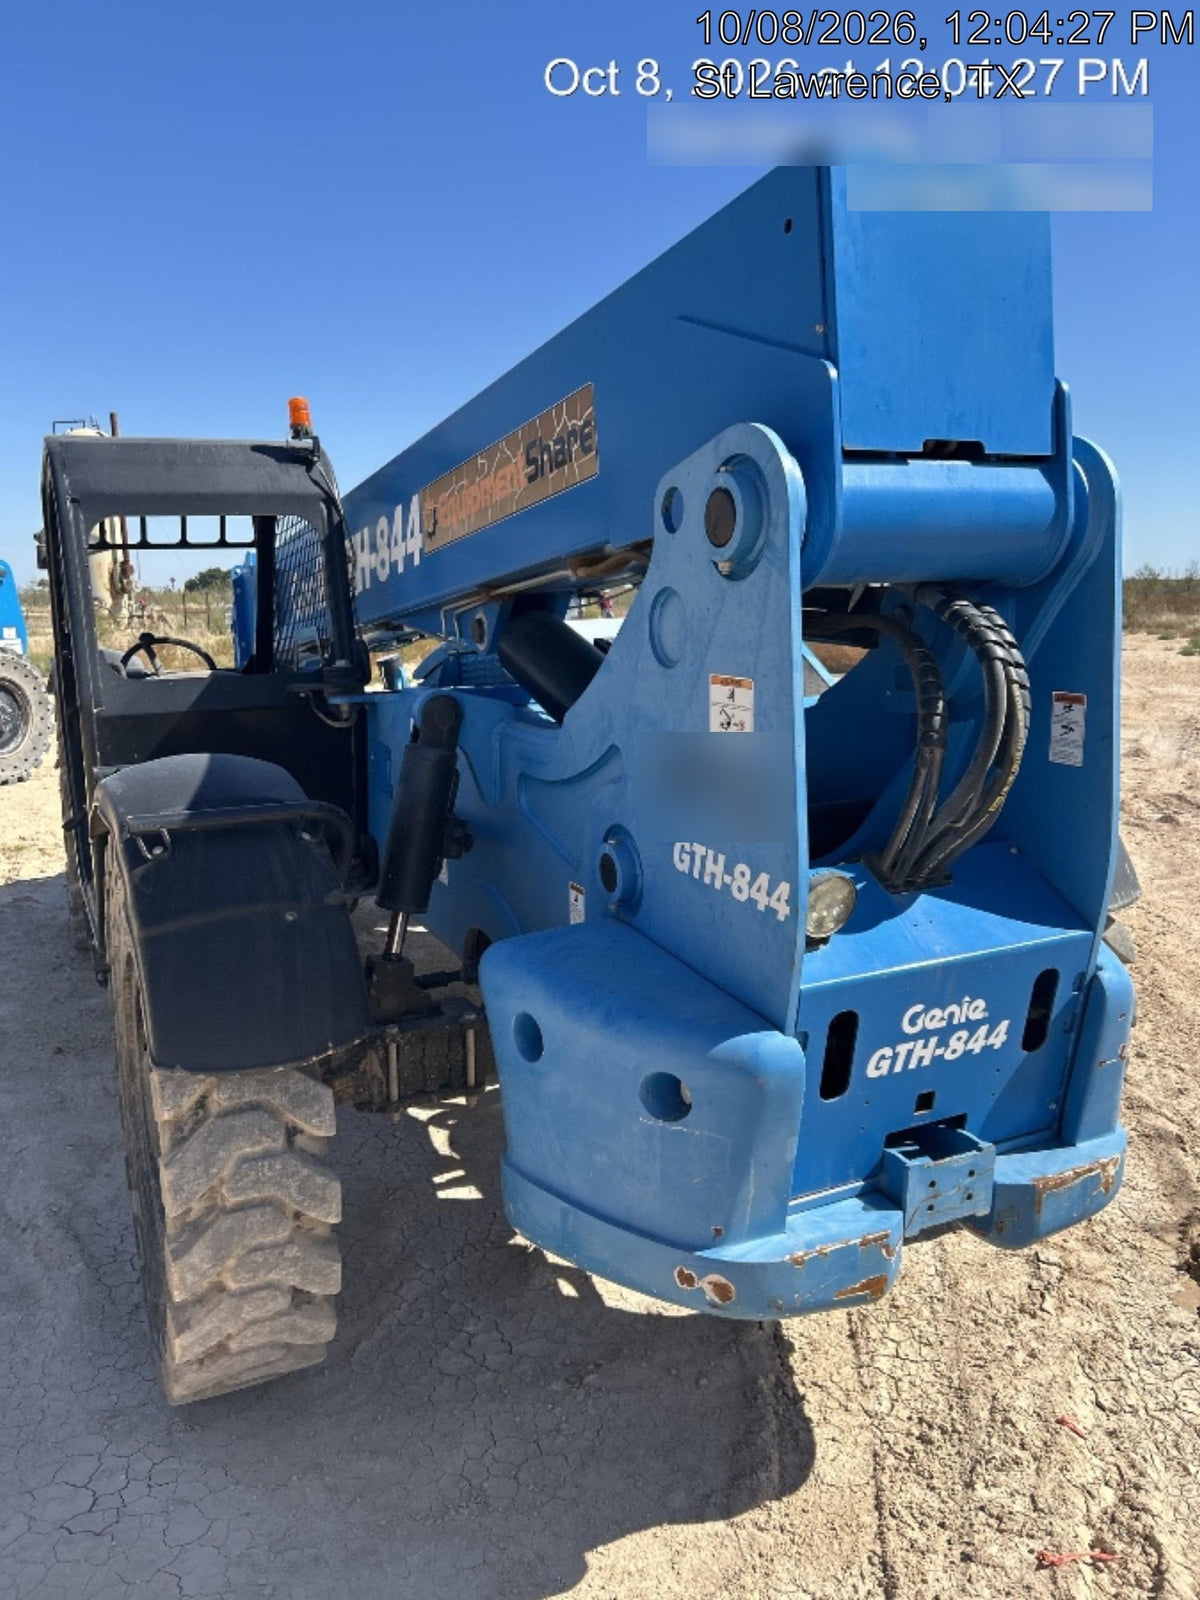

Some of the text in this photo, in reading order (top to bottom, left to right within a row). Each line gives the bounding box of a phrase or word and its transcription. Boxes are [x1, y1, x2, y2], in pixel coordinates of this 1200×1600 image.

[673, 842, 791, 921] GTH-844
[902, 995, 988, 1034] Genie
[865, 1019, 1011, 1078] GTH-844
